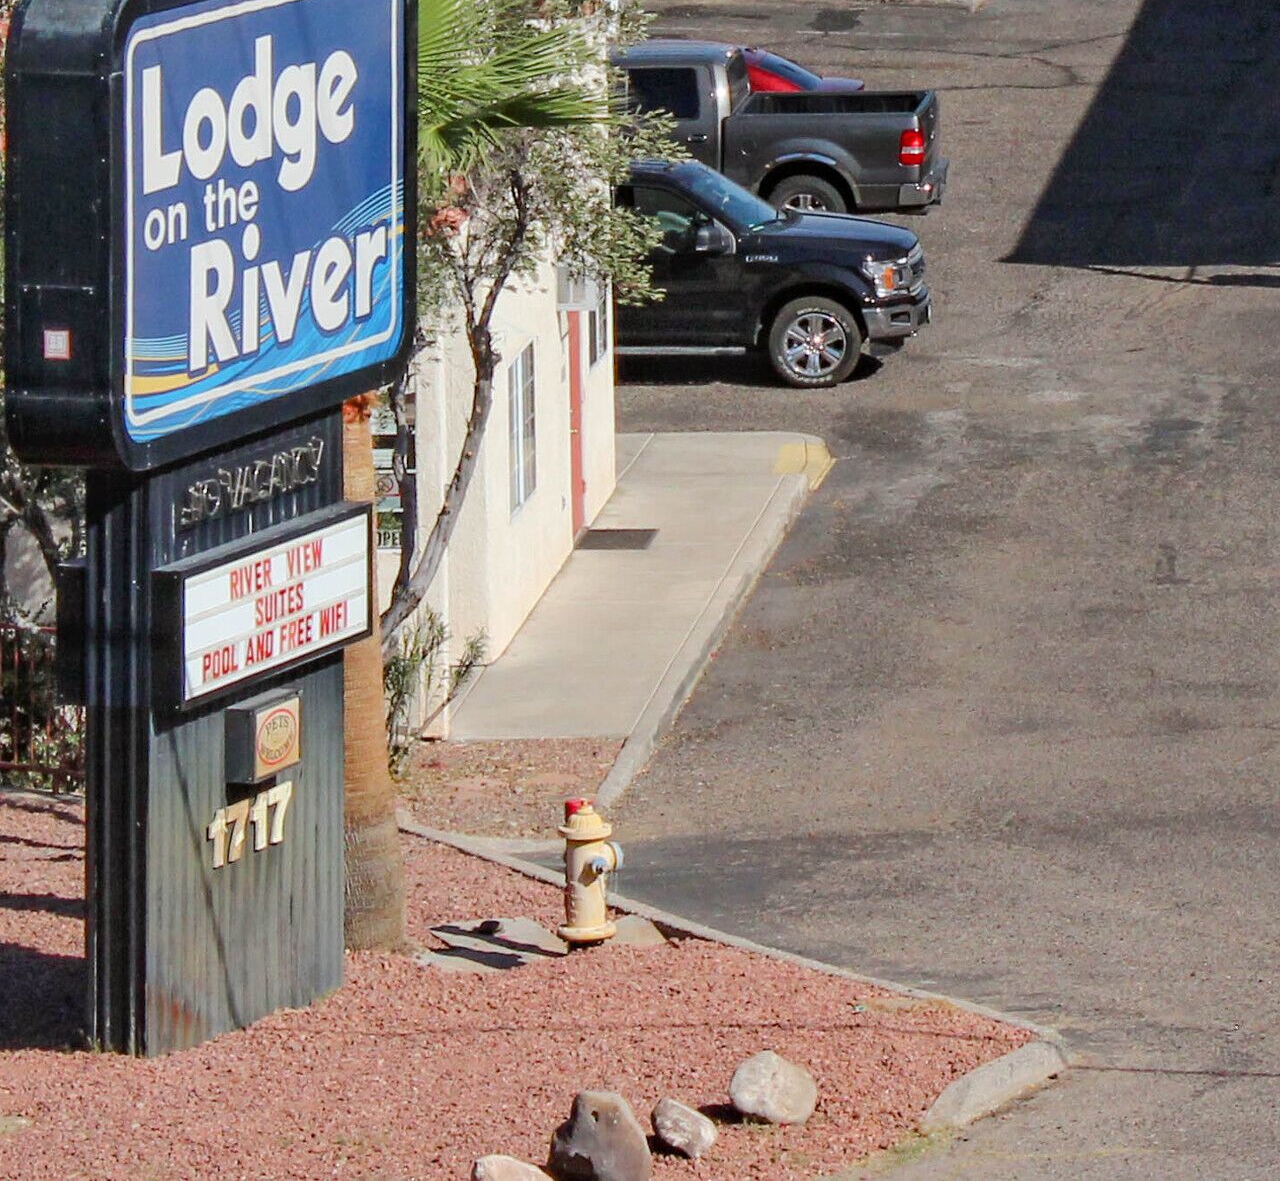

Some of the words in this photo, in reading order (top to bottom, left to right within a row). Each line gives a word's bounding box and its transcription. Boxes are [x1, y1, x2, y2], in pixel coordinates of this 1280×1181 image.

[141, 34, 359, 195] Lodge
[144, 199, 187, 251] on
[204, 178, 260, 232] the
[189, 222, 387, 373] River
[228, 557, 272, 602] RIVER
[286, 539, 324, 578] VIEW
[377, 530, 402, 547] PE
[255, 582, 305, 628] SUITES
[202, 644, 239, 684] POOL
[245, 630, 274, 667] AND
[279, 614, 313, 654] FREE
[319, 600, 349, 638] WIFI
[265, 714, 290, 736] PETS
[206, 780, 293, 870] 1717
